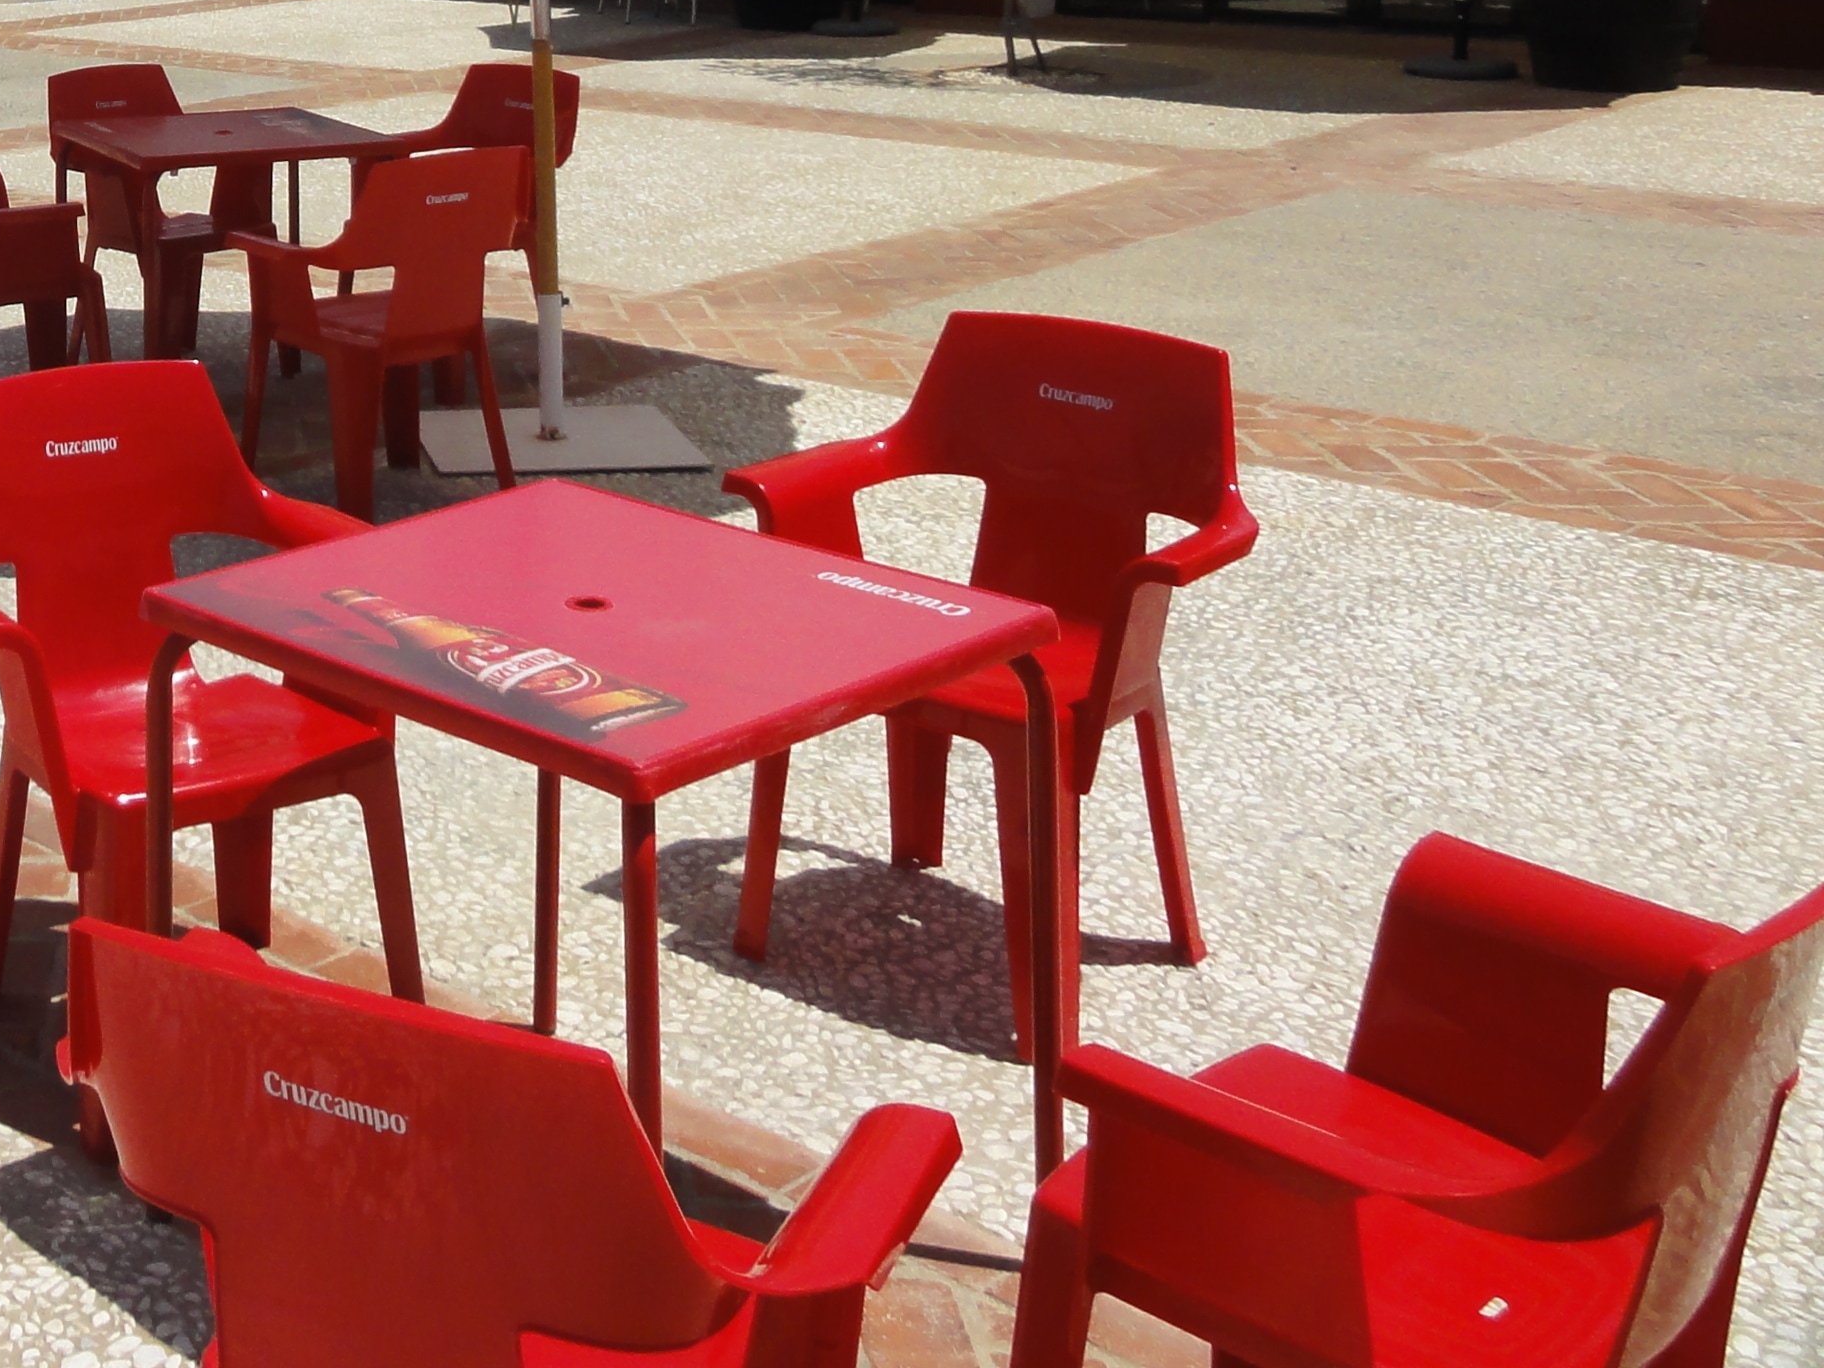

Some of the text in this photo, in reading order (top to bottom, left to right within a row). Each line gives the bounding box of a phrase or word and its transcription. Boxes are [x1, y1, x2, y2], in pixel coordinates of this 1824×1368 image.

[1039, 382, 1113, 410] Cruzcampo
[45, 437, 117, 457] Cruzcampo
[817, 571, 971, 616] Cruzcampo
[263, 1070, 407, 1135] Cruzcampo
